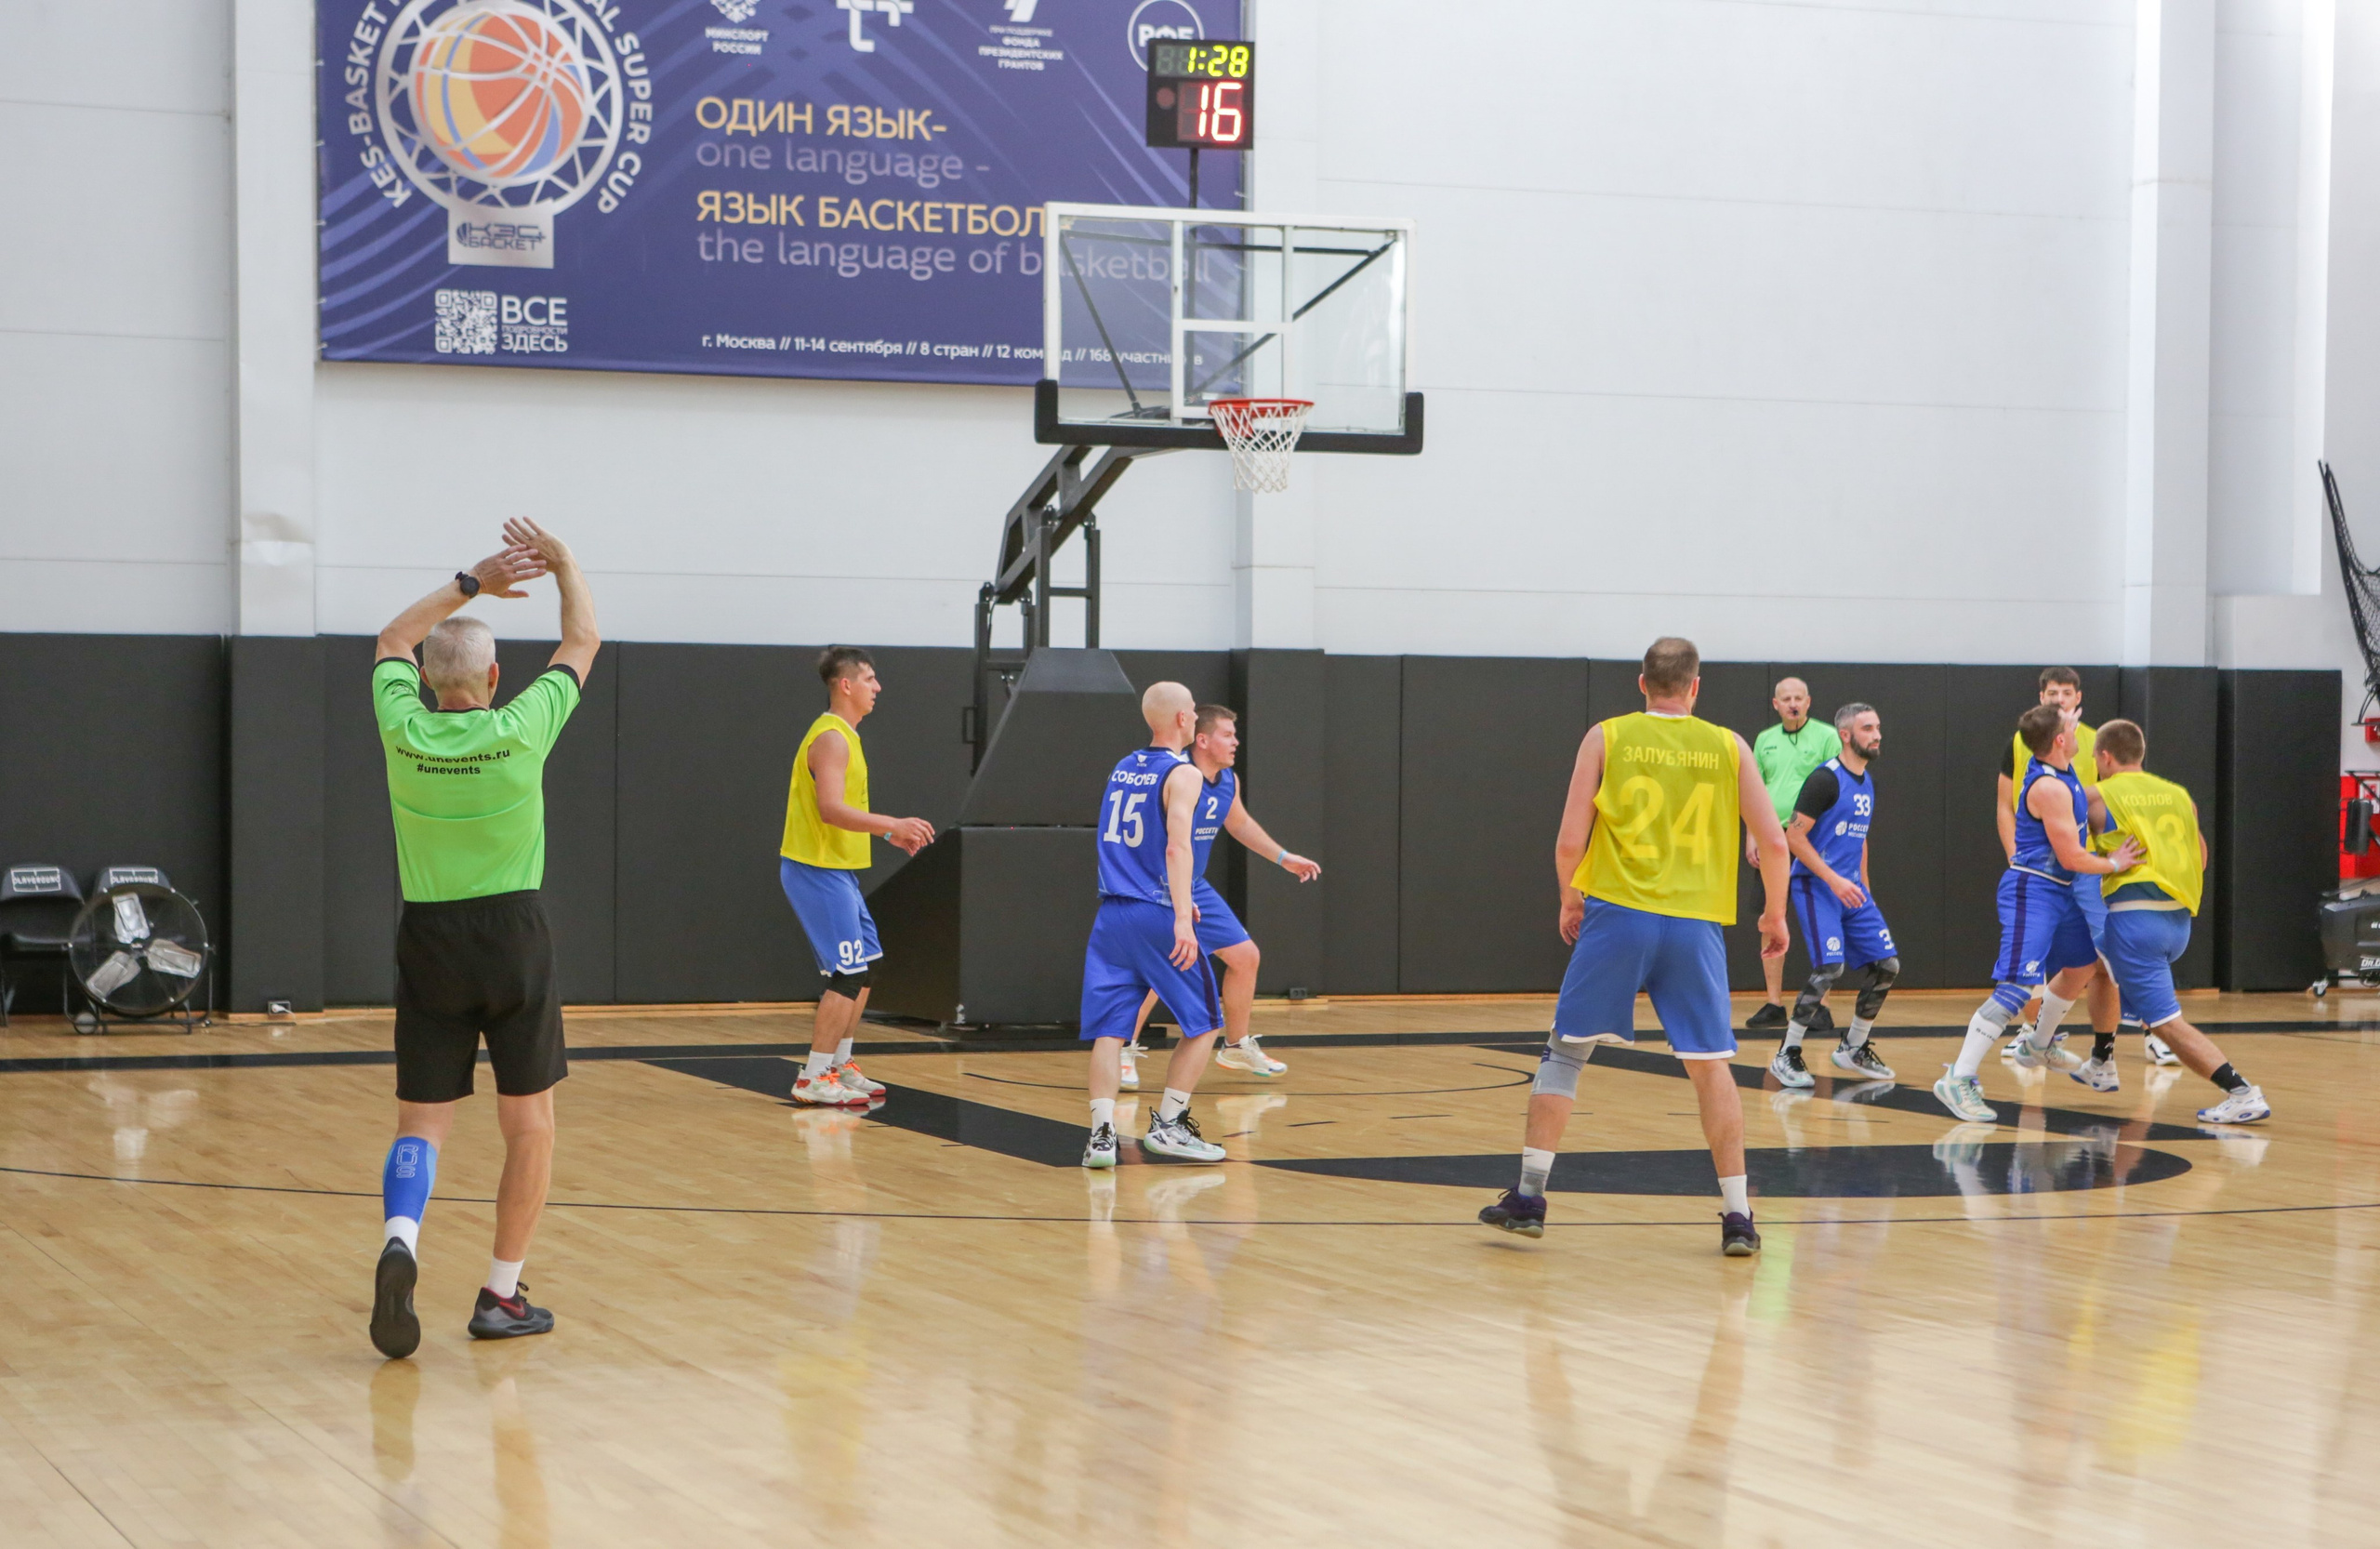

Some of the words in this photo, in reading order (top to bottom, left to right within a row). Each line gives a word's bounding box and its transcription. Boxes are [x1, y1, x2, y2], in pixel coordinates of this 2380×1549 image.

[705, 26, 770, 42] МИНСПОРТ
[712, 41, 762, 55] РОССИИ
[1002, 36, 1041, 48] ФОНДА
[978, 46, 1064, 60] ПРЕЗИДЕНТСКИХ
[998, 58, 1044, 71] ГРАНТОВ
[1187, 45, 1250, 78] 1:28
[615, 32, 653, 145] SUPER
[695, 96, 813, 137] ОДИН
[826, 104, 947, 140] ЯЗЫК-
[1197, 81, 1243, 142] 16
[696, 142, 772, 170] one
[785, 139, 963, 189] language
[598, 151, 641, 214] CUP
[696, 190, 805, 227] ЯЗЫК
[818, 196, 1071, 238] БАСКЕТБОЛ
[697, 228, 765, 264] the
[778, 231, 956, 281] language
[969, 240, 1011, 274] of
[502, 295, 568, 326] ВСЕ
[501, 333, 568, 353] ЗДЕСЬ
[702, 336, 712, 348] г.
[716, 334, 775, 351] Москва
[794, 338, 826, 351] 11-14
[828, 338, 903, 358] сентября
[919, 341, 930, 356] 8
[932, 342, 979, 360] стран
[996, 344, 1011, 359] 12
[1013, 346, 1073, 362] комд
[1090, 348, 1112, 362] 168
[416, 763, 481, 774] #unevents
[1104, 789, 1147, 848] 15
[1205, 797, 1218, 819] 2
[1853, 793, 1871, 816] 33
[1619, 774, 1715, 865] 24
[839, 939, 865, 966] 92
